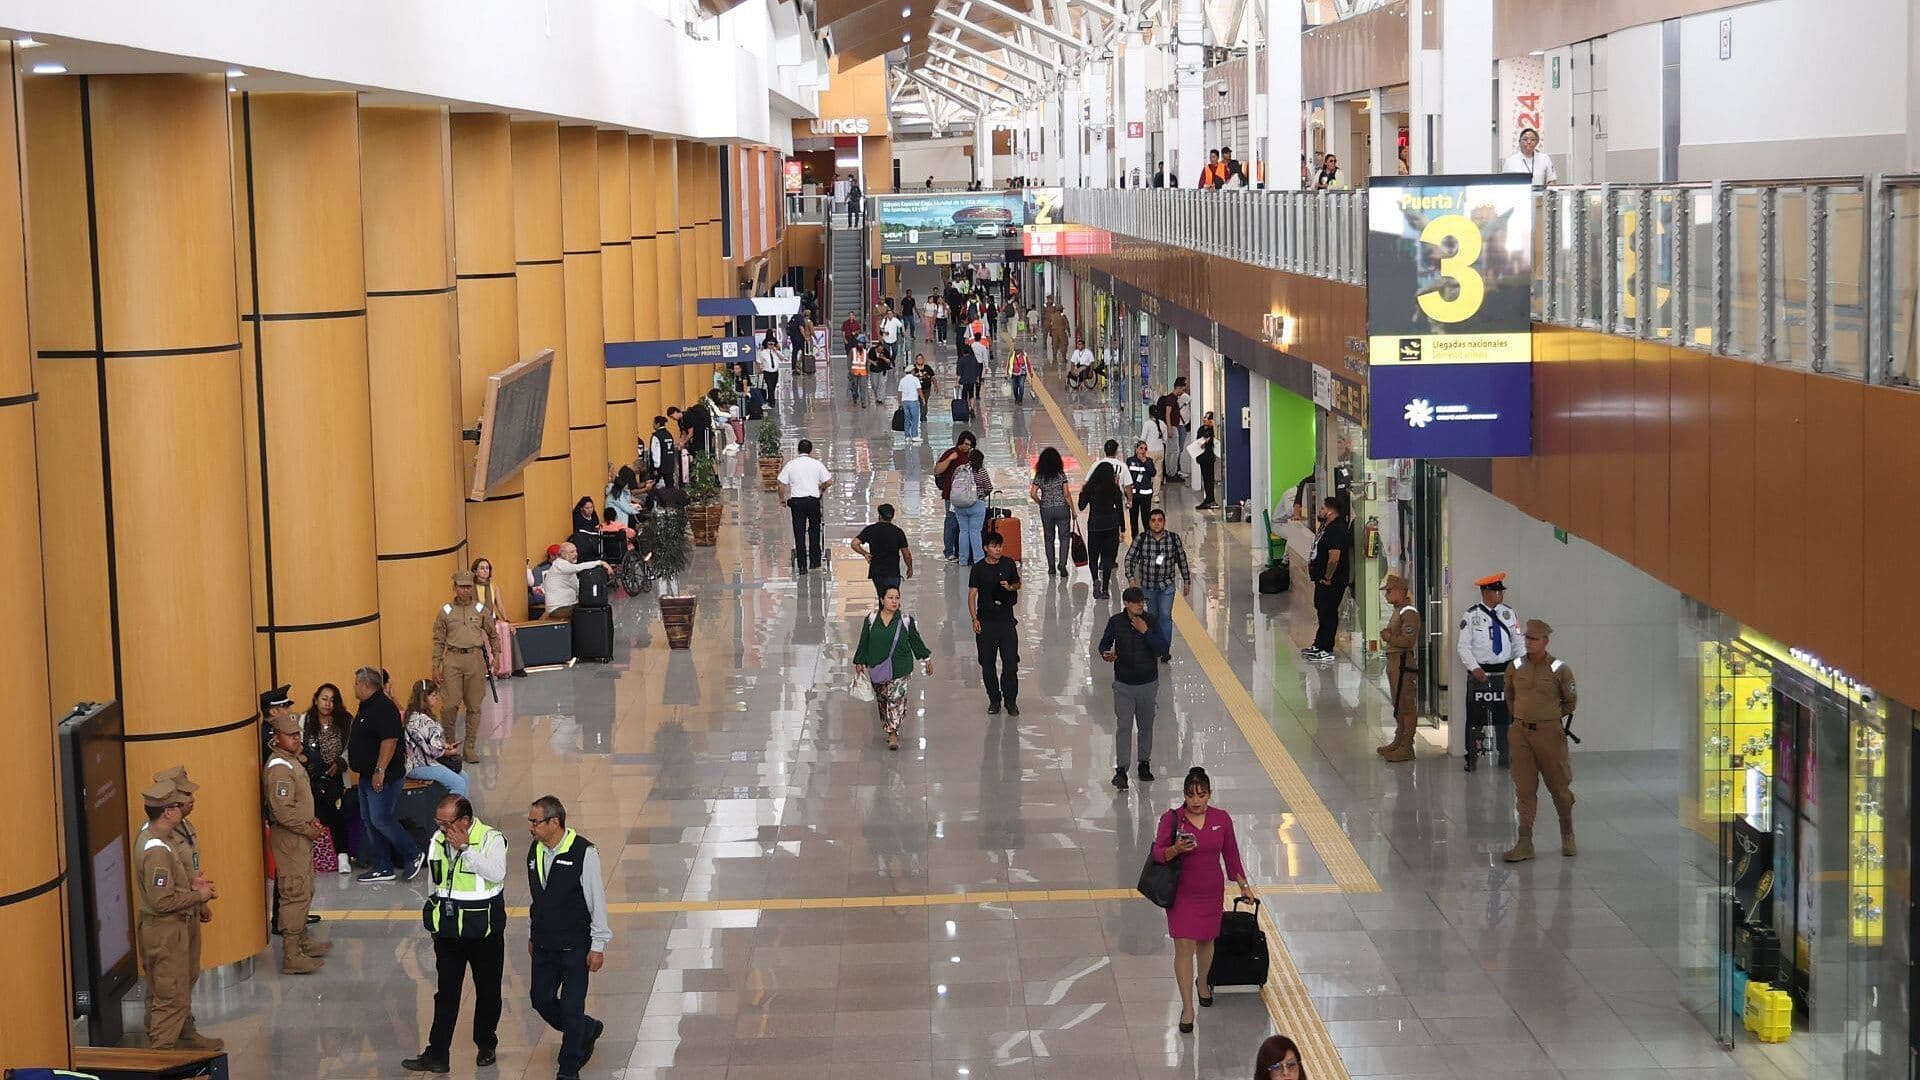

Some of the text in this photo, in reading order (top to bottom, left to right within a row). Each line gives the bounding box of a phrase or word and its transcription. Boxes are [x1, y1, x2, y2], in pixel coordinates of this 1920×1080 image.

[1516, 92, 1541, 129] 24
[1034, 194, 1053, 225] 2
[1402, 193, 1453, 210] Puerta
[918, 253, 926, 263] A
[1416, 214, 1486, 324] 3
[1432, 339, 1508, 351] Llegadas nacionales
